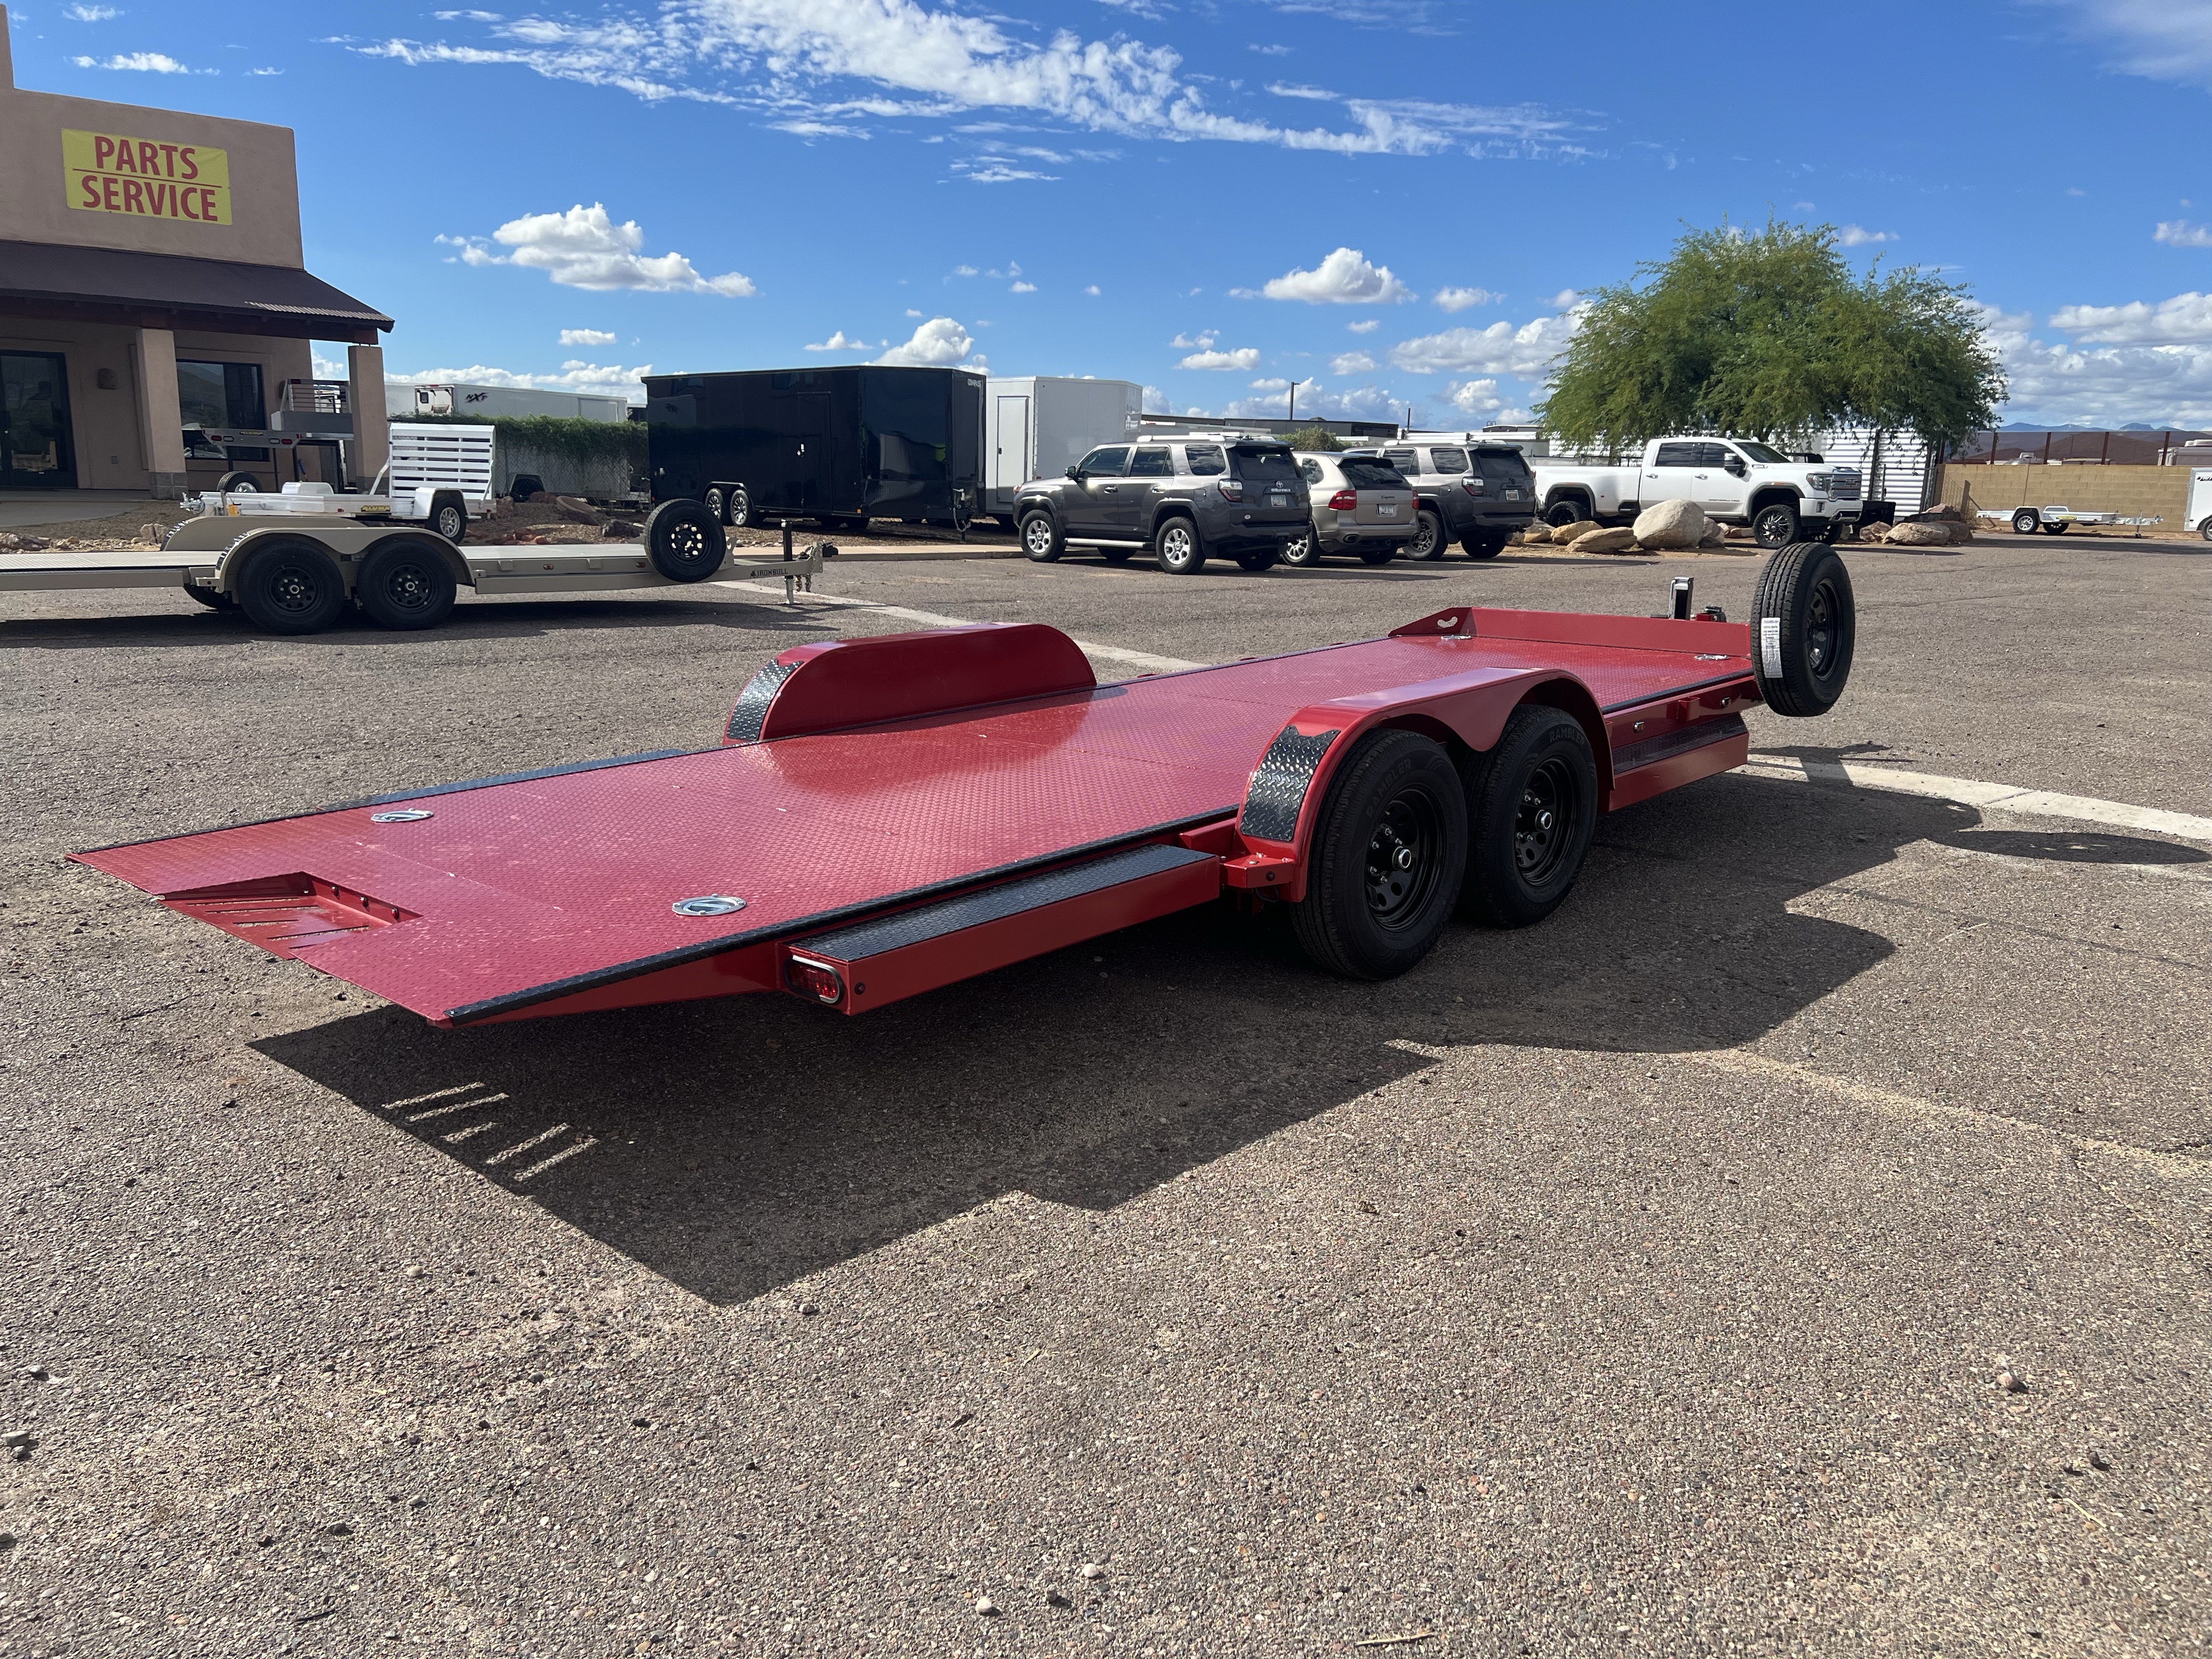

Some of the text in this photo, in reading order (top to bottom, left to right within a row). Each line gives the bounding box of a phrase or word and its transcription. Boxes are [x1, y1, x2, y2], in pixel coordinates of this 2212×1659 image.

[94, 136, 198, 179] PARTS
[82, 175, 218, 222] SERVICE
[465, 392, 489, 403] NXT
[757, 568, 788, 577] IRONBULL
[1549, 727, 1585, 748] RAMBLER
[1364, 758, 1412, 819] RAMBLER
